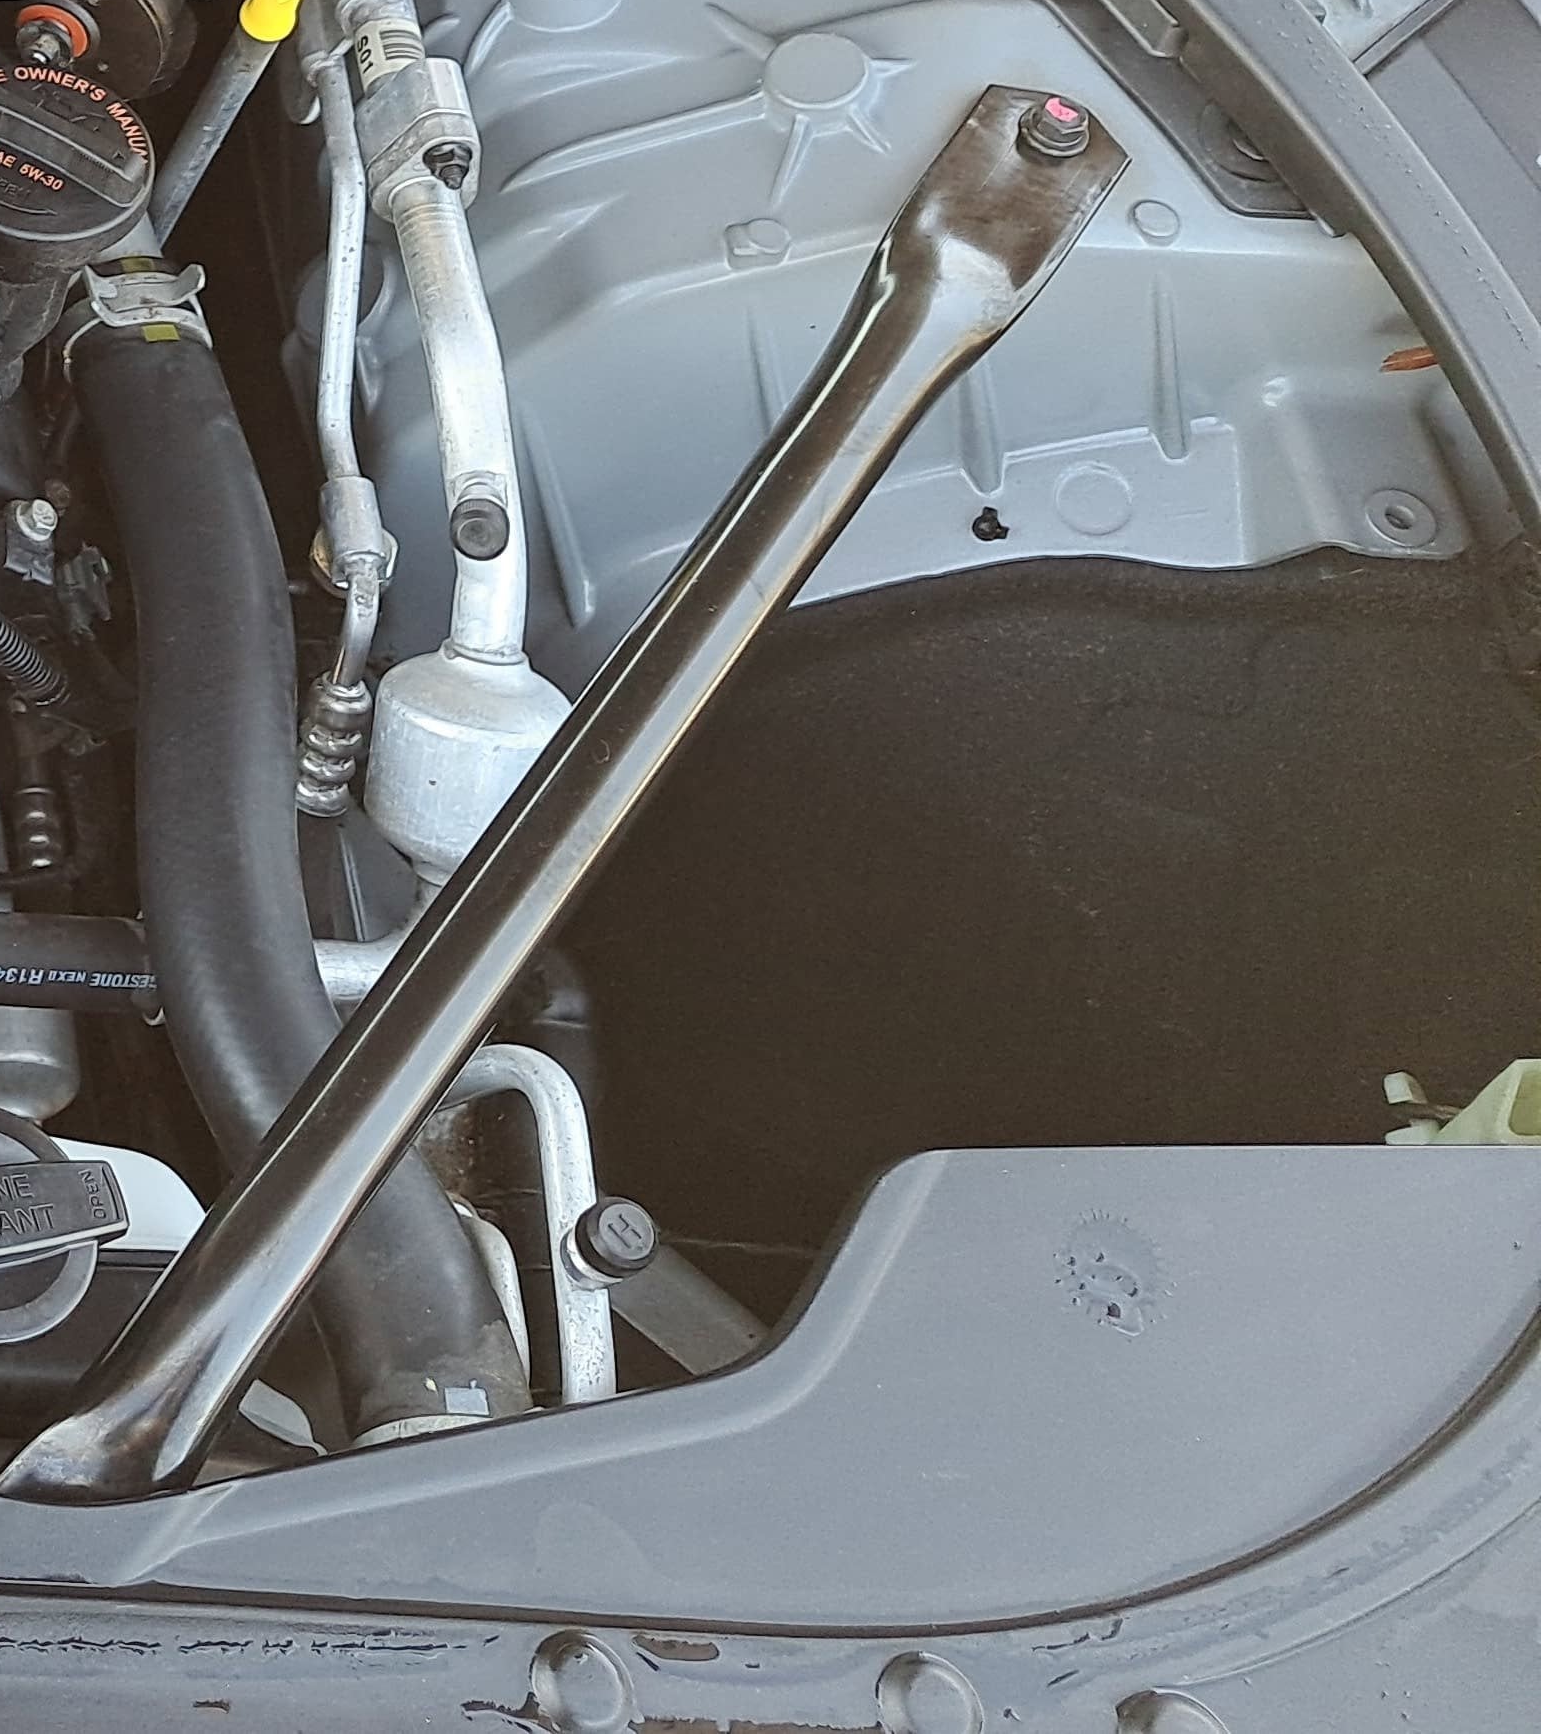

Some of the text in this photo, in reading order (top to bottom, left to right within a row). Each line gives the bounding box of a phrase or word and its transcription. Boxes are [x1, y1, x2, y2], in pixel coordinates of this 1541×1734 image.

[356, 34, 374, 74] S01
[13, 66, 107, 102] OWNER'S
[18, 163, 65, 192] 5W-30
[78, 1167, 107, 1220] OPEN
